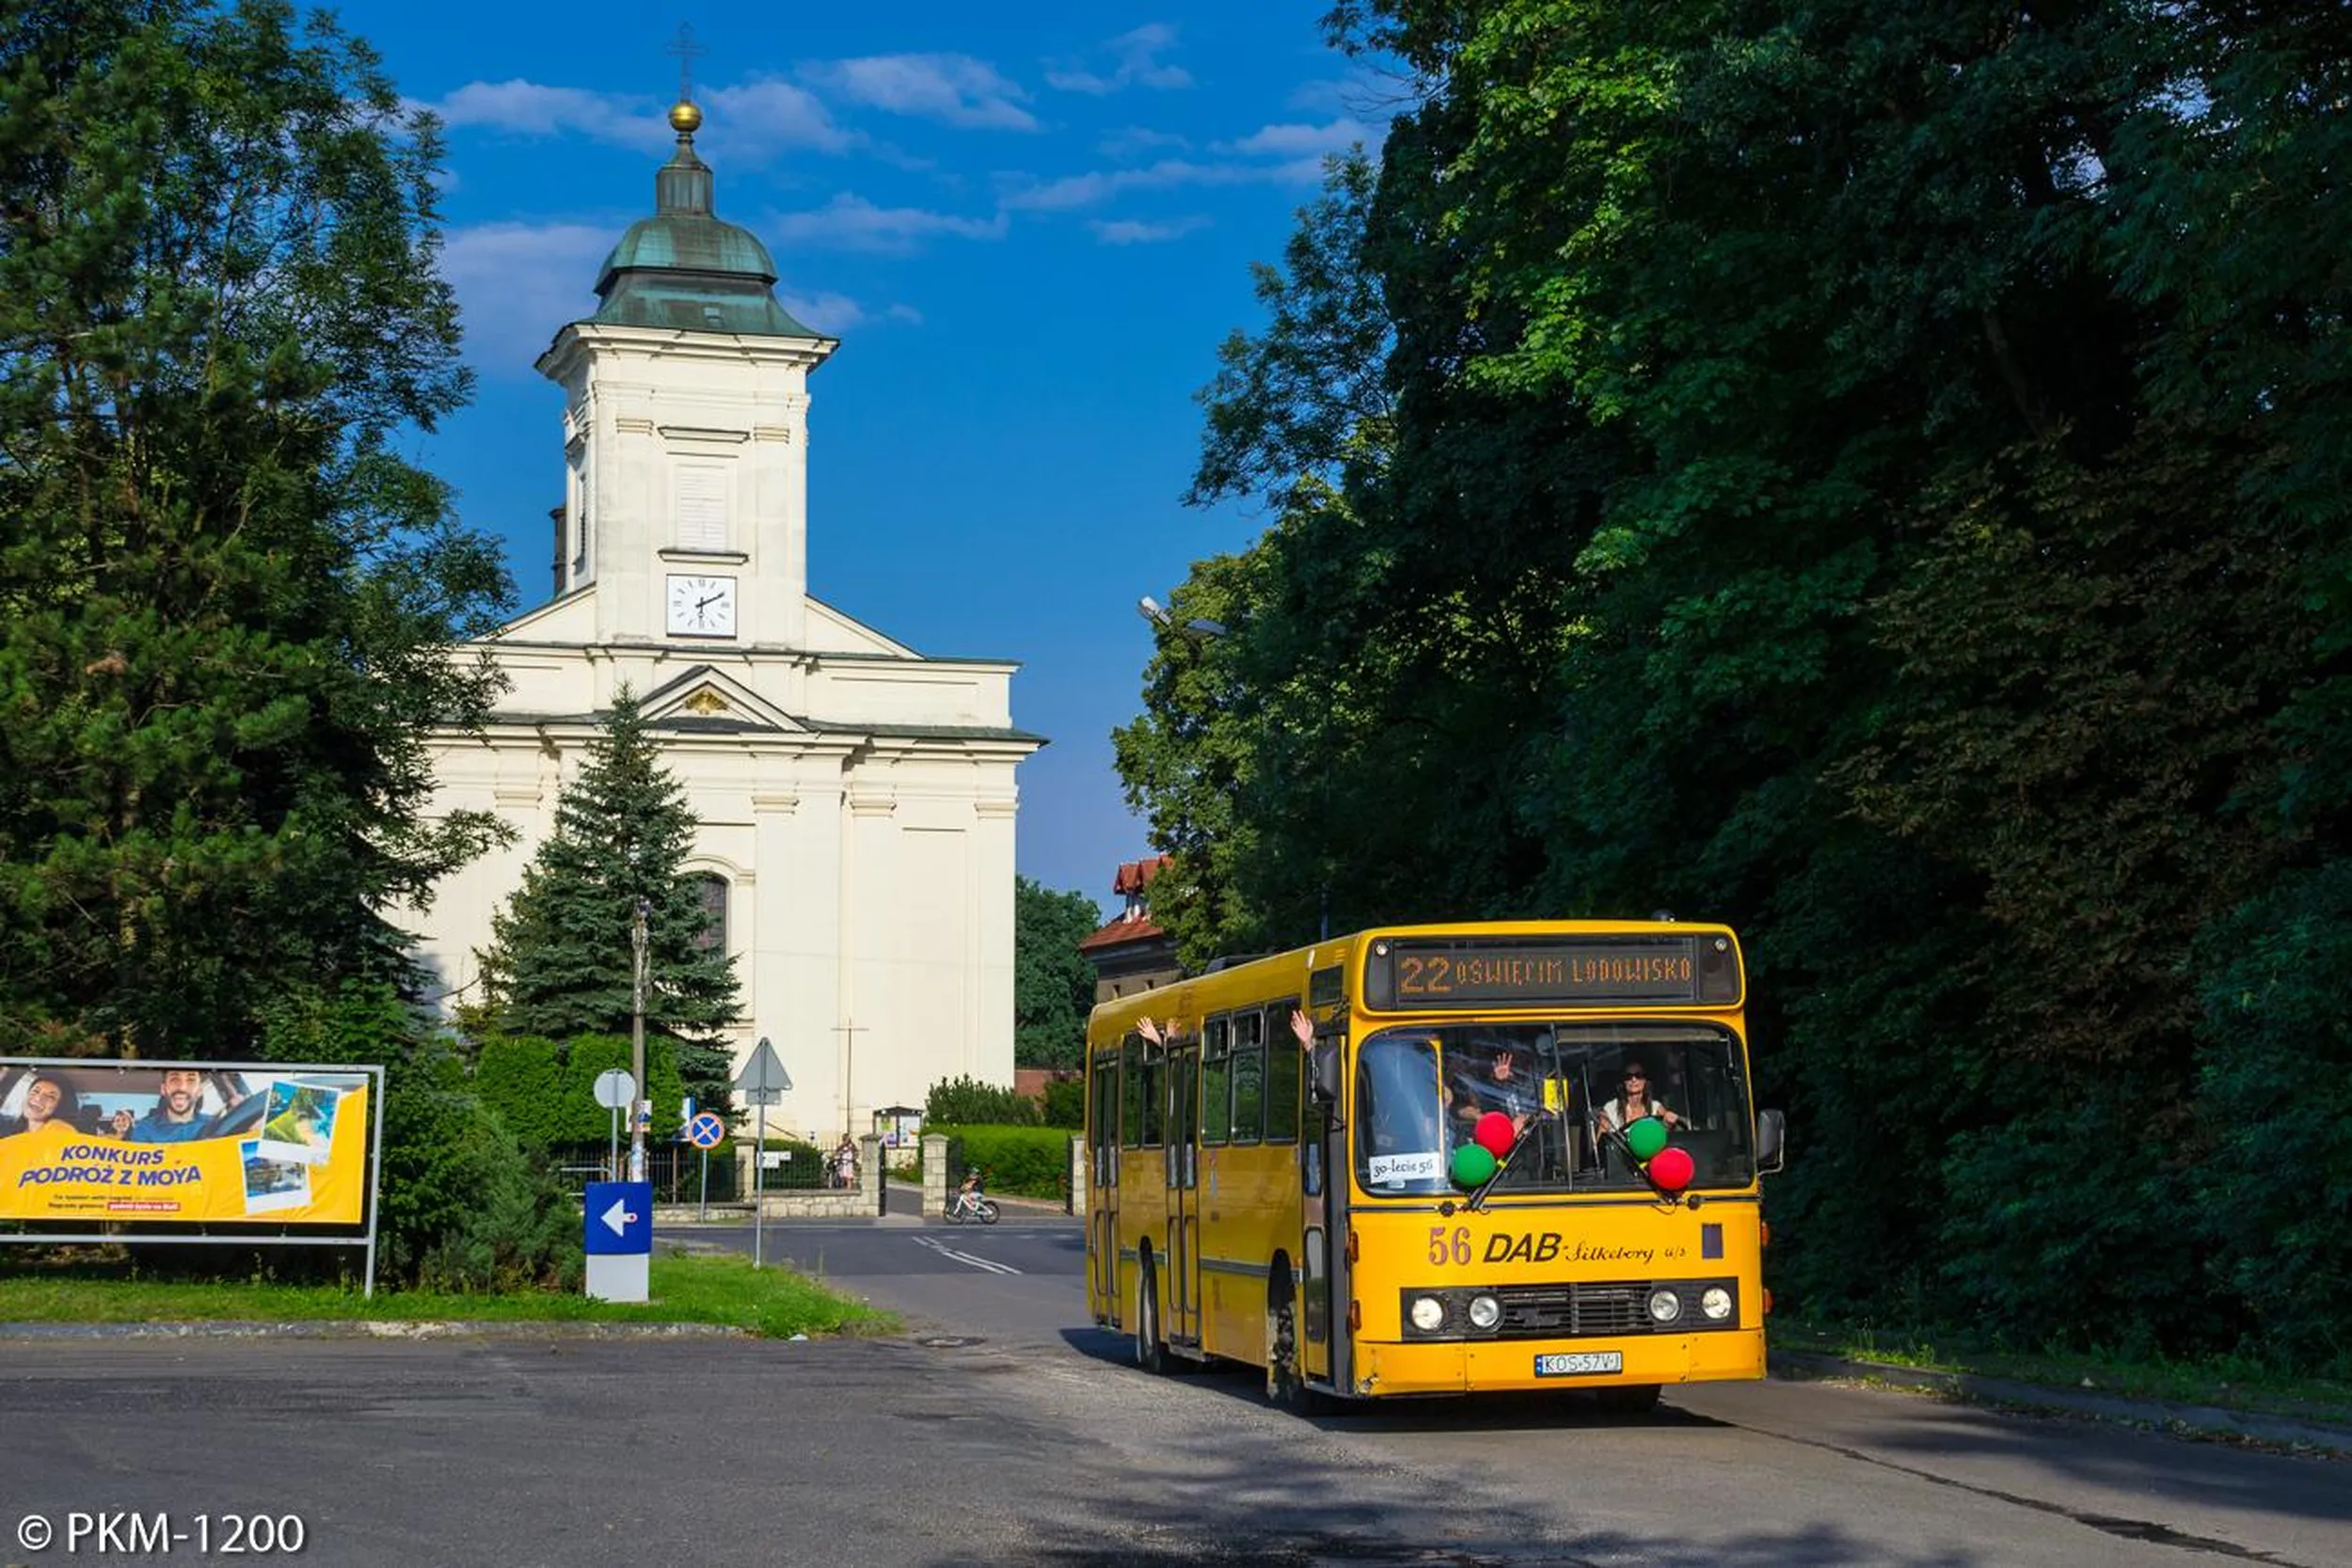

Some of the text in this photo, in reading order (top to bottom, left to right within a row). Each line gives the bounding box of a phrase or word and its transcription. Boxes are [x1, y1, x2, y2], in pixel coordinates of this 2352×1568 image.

[1400, 957, 1451, 993] 22
[1572, 957, 1691, 982] LODOWISKO
[60, 1145, 165, 1165] KONKURS
[18, 1164, 201, 1188] PODRÓŻ Z MOYA
[1428, 1226, 1471, 1266] 56
[1483, 1232, 1562, 1263] DAB
